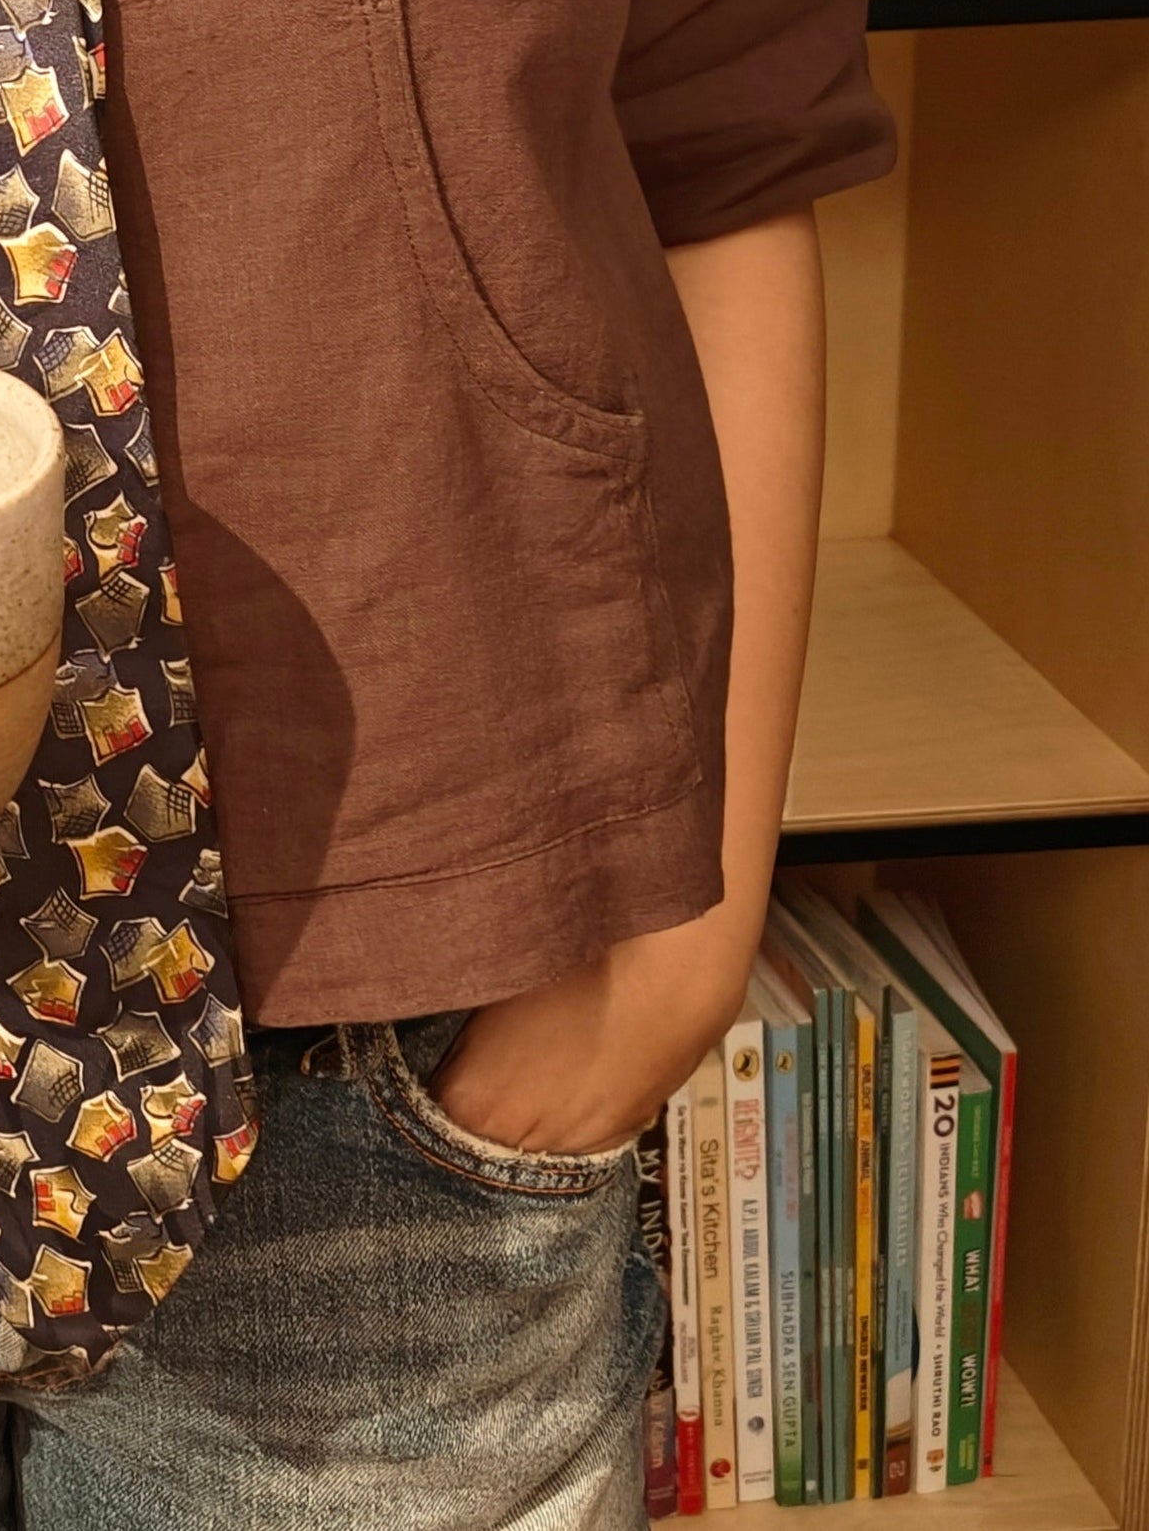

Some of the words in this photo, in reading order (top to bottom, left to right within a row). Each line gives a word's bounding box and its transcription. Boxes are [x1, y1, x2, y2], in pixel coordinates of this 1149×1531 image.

[861, 1063, 871, 1112] UNLOCK
[934, 1094, 955, 1138] 20
[639, 1149, 660, 1185] MY
[700, 1139, 719, 1197] Sita's
[859, 1139, 871, 1183] ANIMAL
[938, 1143, 952, 1199] INDIANS
[896, 1161, 912, 1267] JELLYBELLIES
[937, 1202, 948, 1229] Who
[702, 1202, 722, 1280] Kitchen
[934, 1231, 948, 1282] Changed
[743, 1263, 760, 1298] KALAM
[963, 1250, 981, 1292] WHAT
[781, 1270, 796, 1356] SUBHADRA
[934, 1284, 946, 1303] the
[708, 1305, 724, 1362] Raghav
[859, 1315, 869, 1356] INGRID
[934, 1304, 946, 1338] World
[746, 1348, 762, 1365] PAL
[782, 1361, 795, 1392] SEN
[712, 1368, 725, 1427] Khanna
[746, 1368, 763, 1399] SINGH
[931, 1353, 944, 1408] SHRUTHI
[959, 1354, 977, 1407] WOW?!
[783, 1396, 797, 1448] GUPTA
[931, 1412, 942, 1438] RAO
